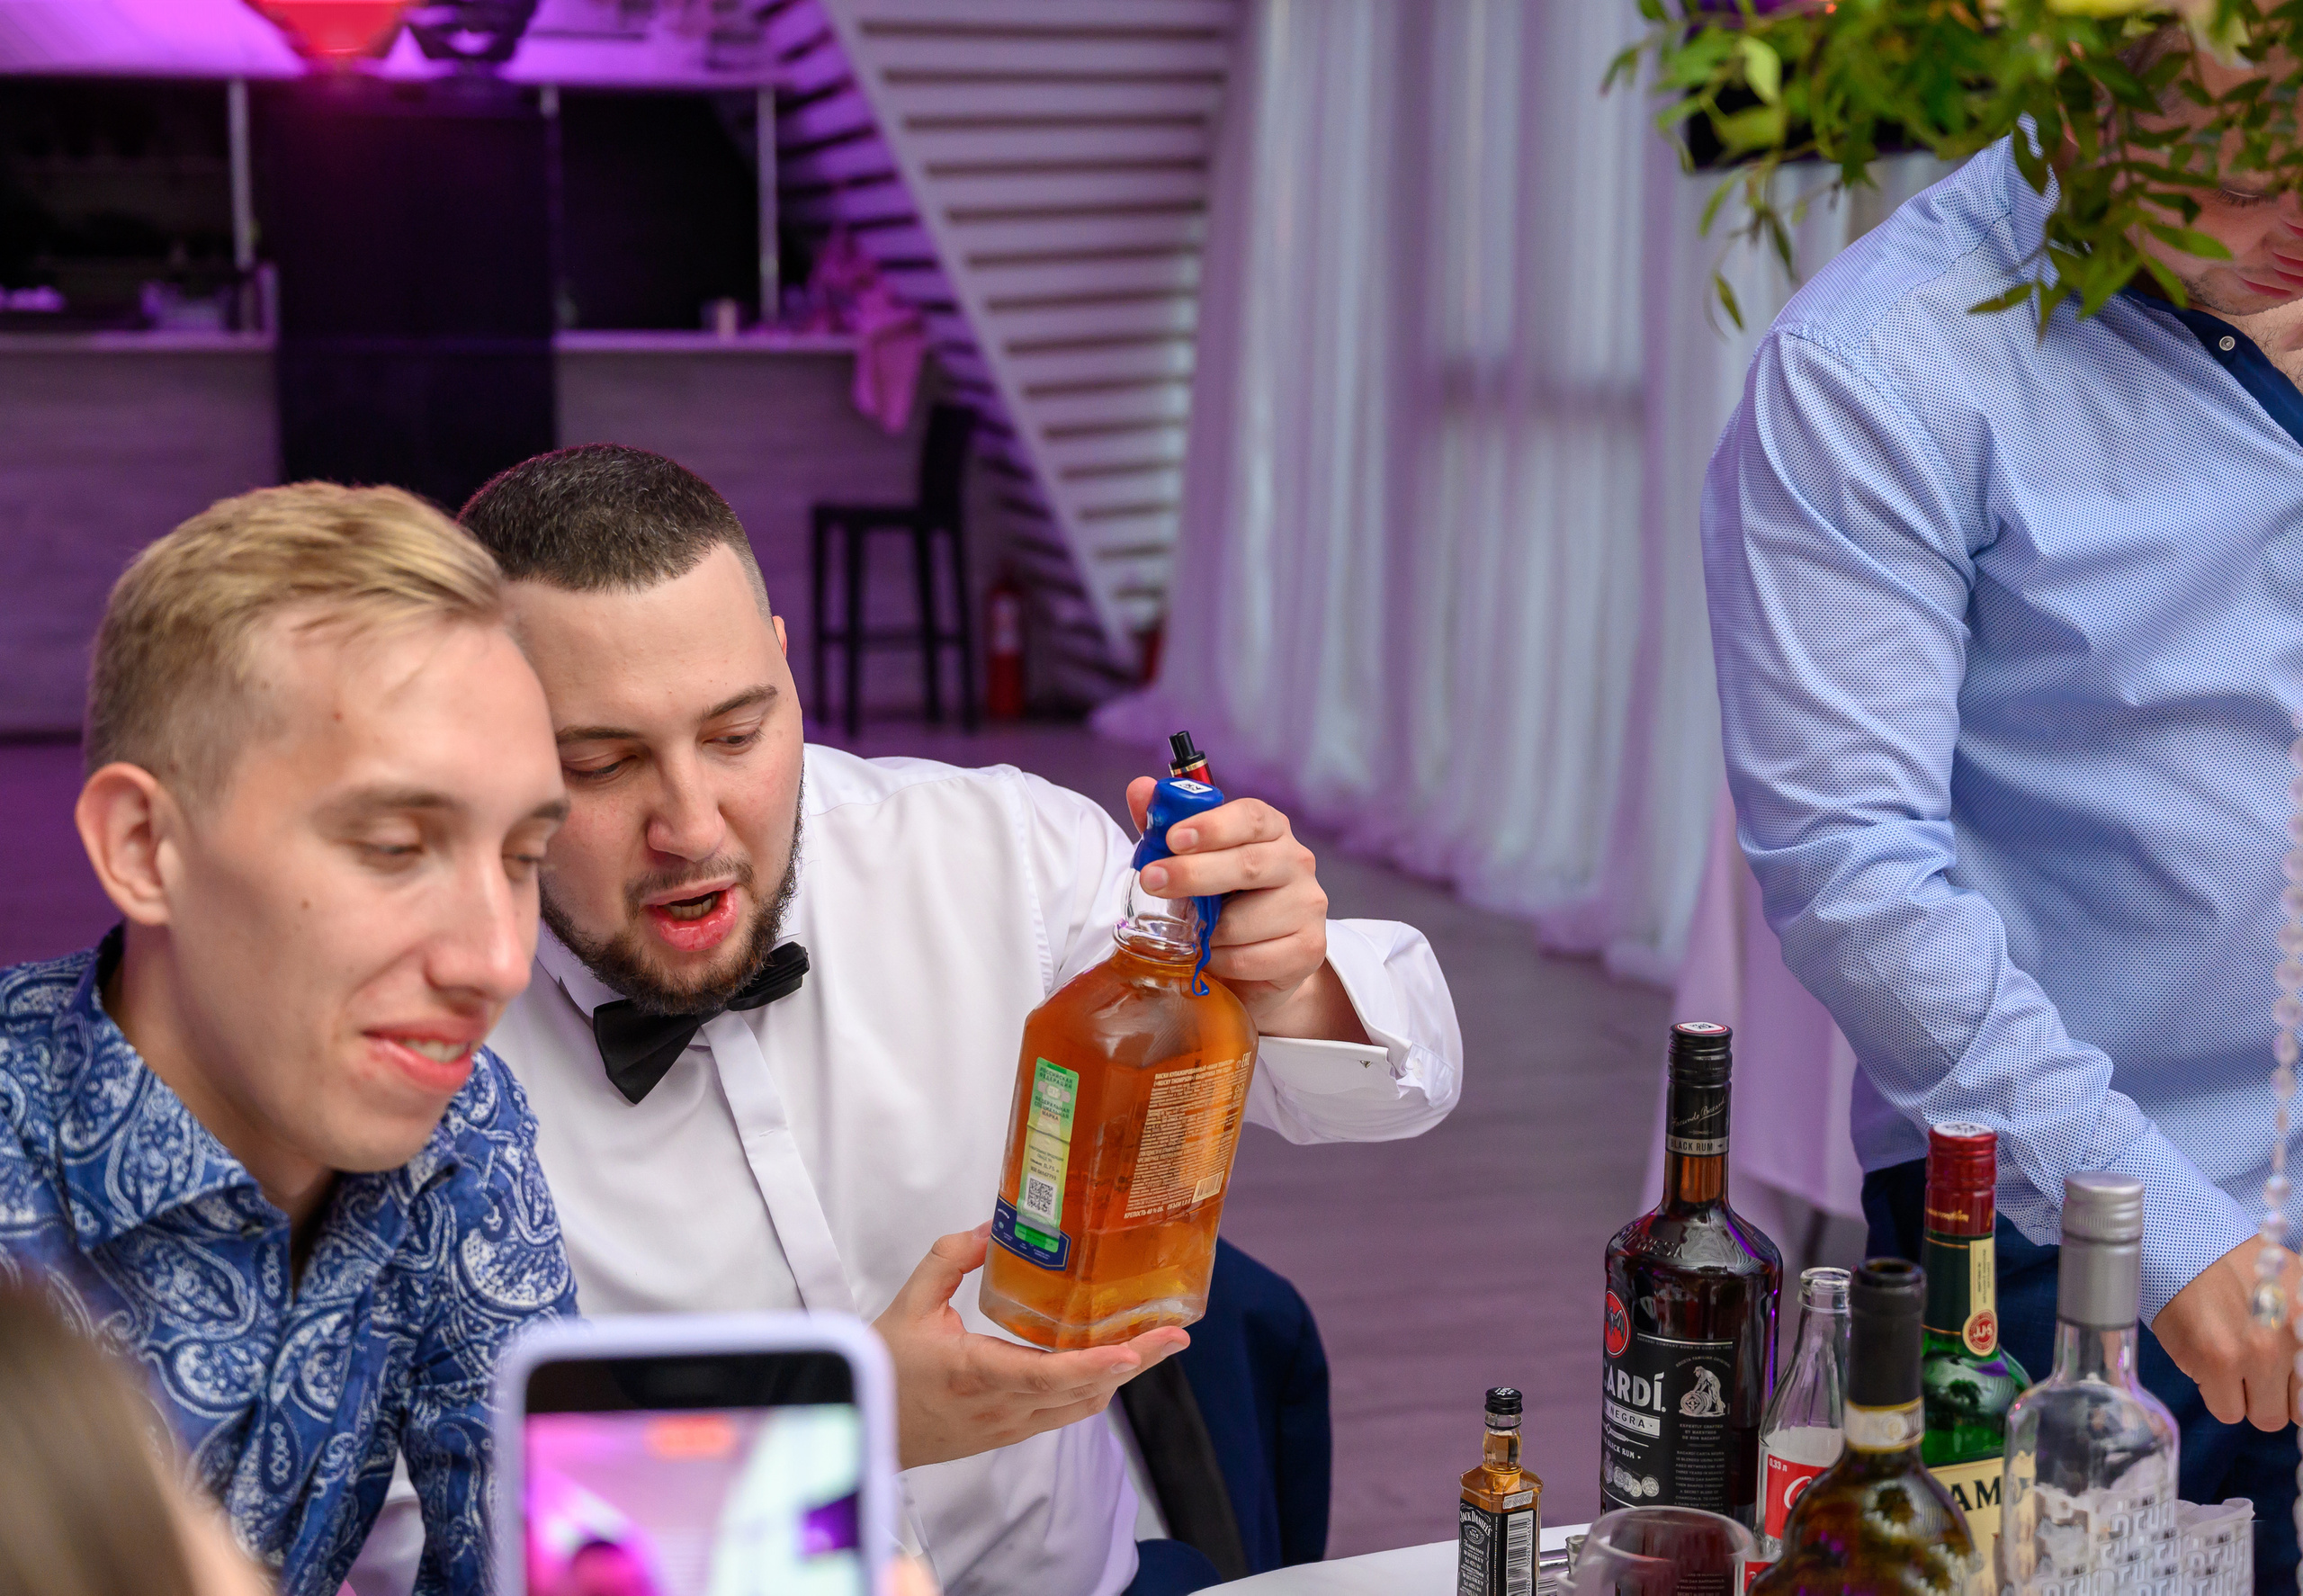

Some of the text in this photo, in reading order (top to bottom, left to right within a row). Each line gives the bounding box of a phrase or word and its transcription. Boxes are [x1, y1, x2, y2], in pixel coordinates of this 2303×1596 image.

[1670, 1139, 1714, 1152] BLACK RUM
[1604, 1363, 1665, 1412] ARDÍ
[1609, 1406, 1645, 1429] NEGRA
[1621, 1448, 1635, 1459] RUM
[1460, 1511, 1472, 1523] JACK
[1463, 1549, 1484, 1564] WHISKEY
